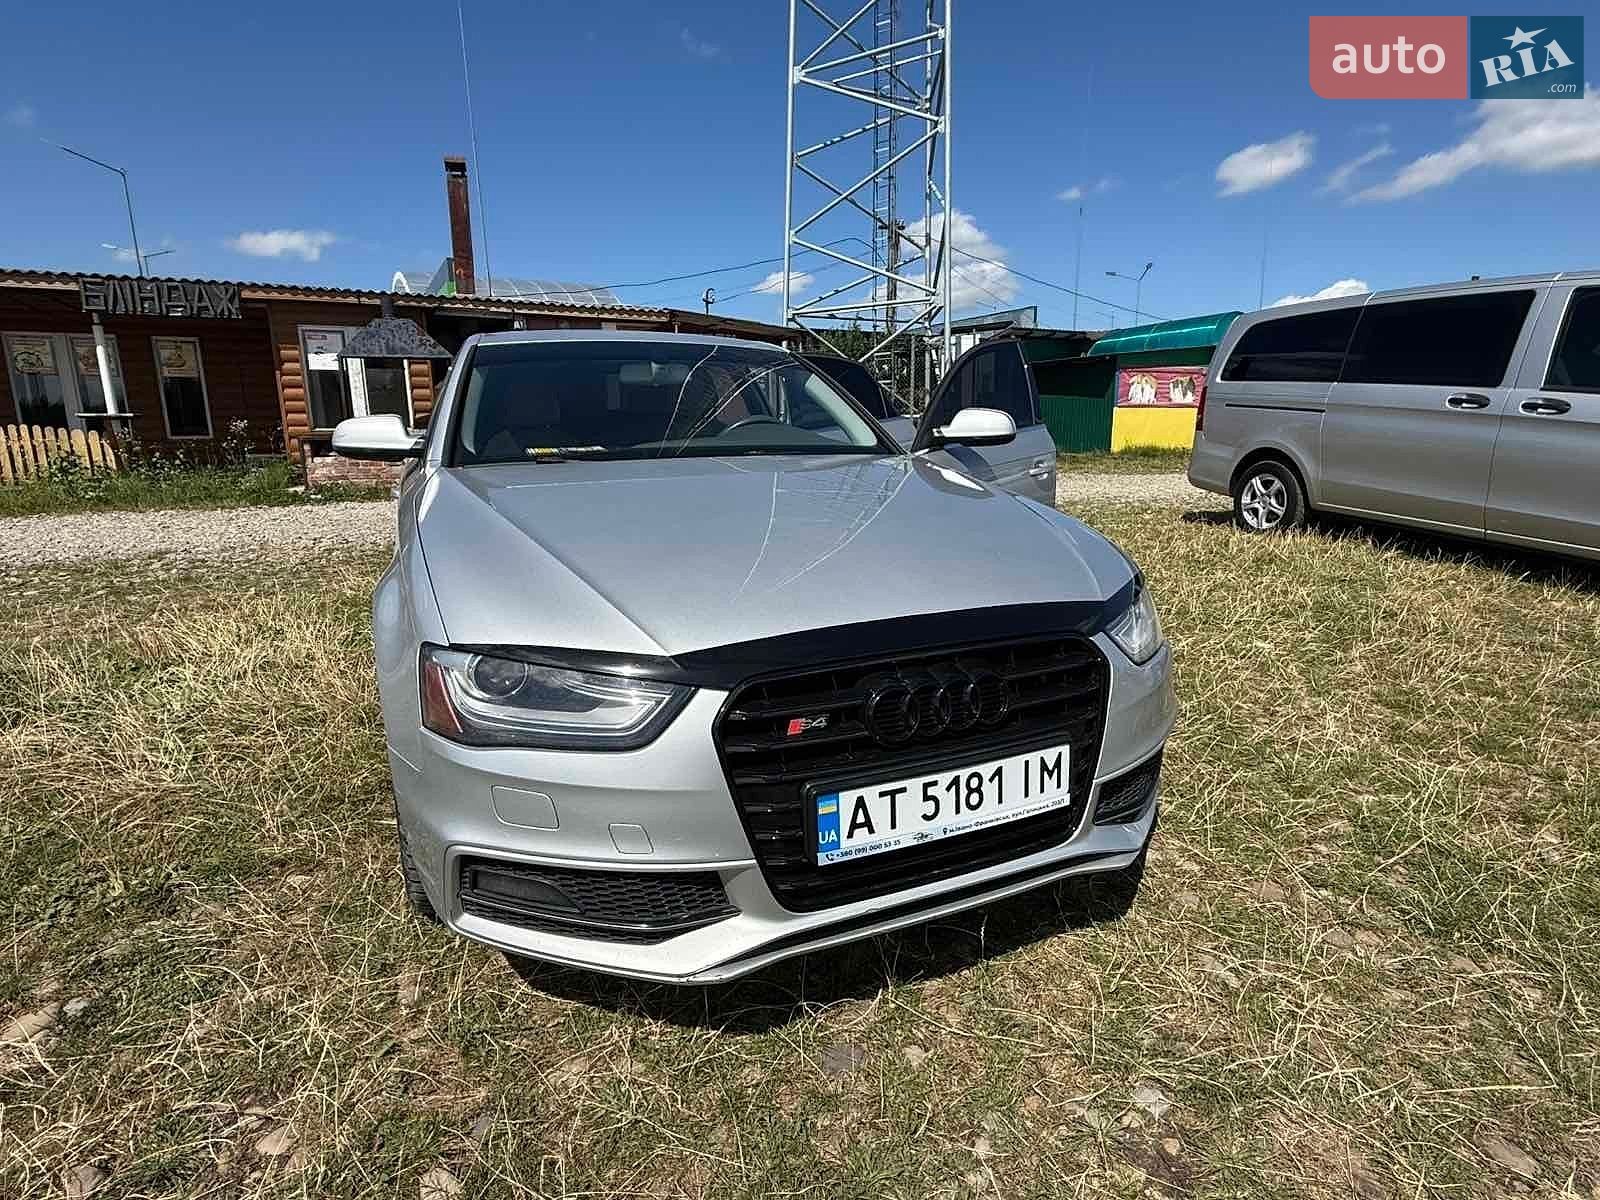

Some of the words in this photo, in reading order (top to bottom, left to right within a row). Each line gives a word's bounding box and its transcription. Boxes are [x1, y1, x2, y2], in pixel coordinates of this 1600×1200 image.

[846, 787, 907, 839] AT
[920, 765, 1004, 822] 5181
[1023, 751, 1063, 799] IM
[818, 829, 838, 844] UA
